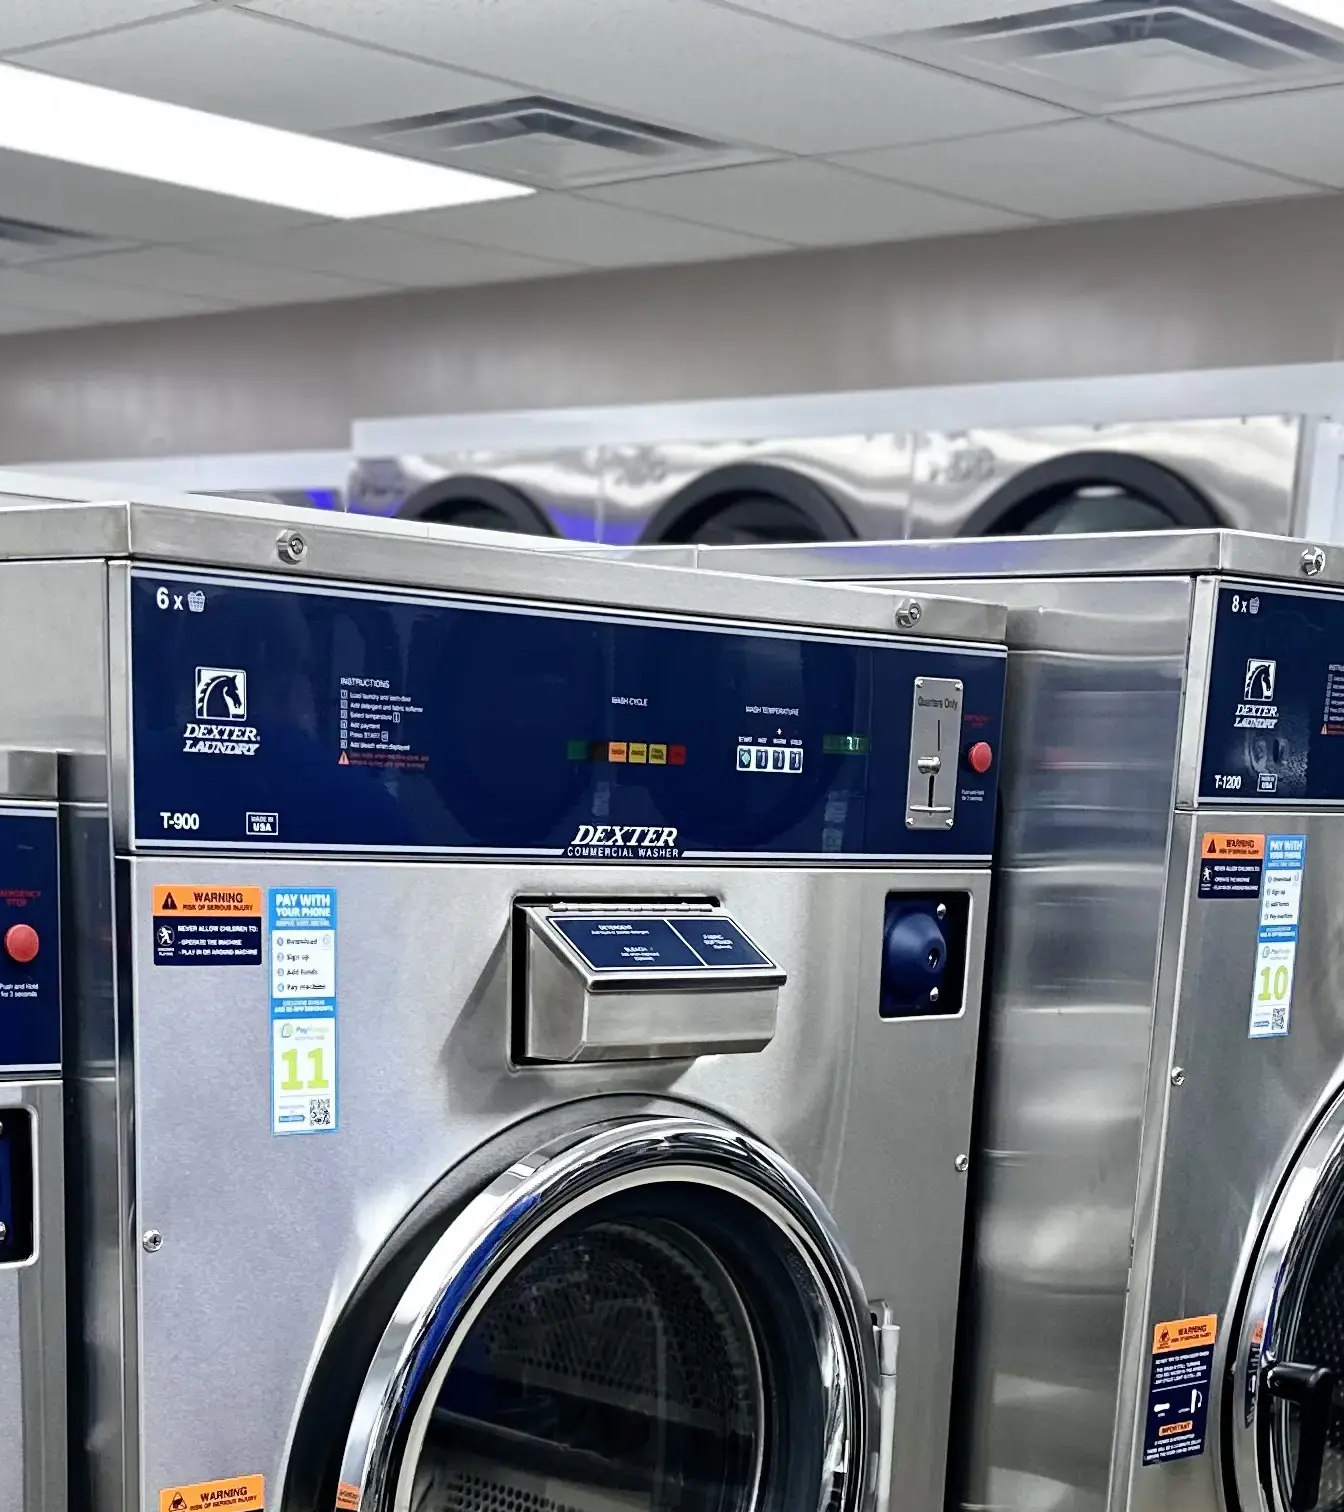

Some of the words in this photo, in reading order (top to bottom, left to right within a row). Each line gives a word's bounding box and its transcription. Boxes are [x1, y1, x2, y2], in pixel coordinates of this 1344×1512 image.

[156, 586, 169, 610] 6
[174, 595, 183, 610] x
[1231, 595, 1239, 613] 8
[1241, 601, 1247, 613] x
[945, 698, 958, 711] Only
[1235, 704, 1278, 717] DEXTER
[183, 723, 258, 741] DEXTER
[182, 740, 260, 756] LAUNDRY
[1215, 775, 1242, 789] T-1200
[160, 811, 200, 830] T-900
[252, 822, 272, 832] USA
[570, 825, 678, 846] DEXTER
[567, 847, 634, 857] COMMERCIAL
[638, 848, 679, 858] WASHER
[1270, 840, 1282, 850] PAY
[193, 892, 244, 903] WARNING
[275, 893, 298, 906] PAY
[299, 893, 331, 906] WITH
[275, 907, 300, 917] YOUR
[301, 907, 331, 917] PHONE
[1258, 965, 1288, 1001] 10
[281, 1047, 329, 1091] 11
[200, 1486, 247, 1502] WARNING
